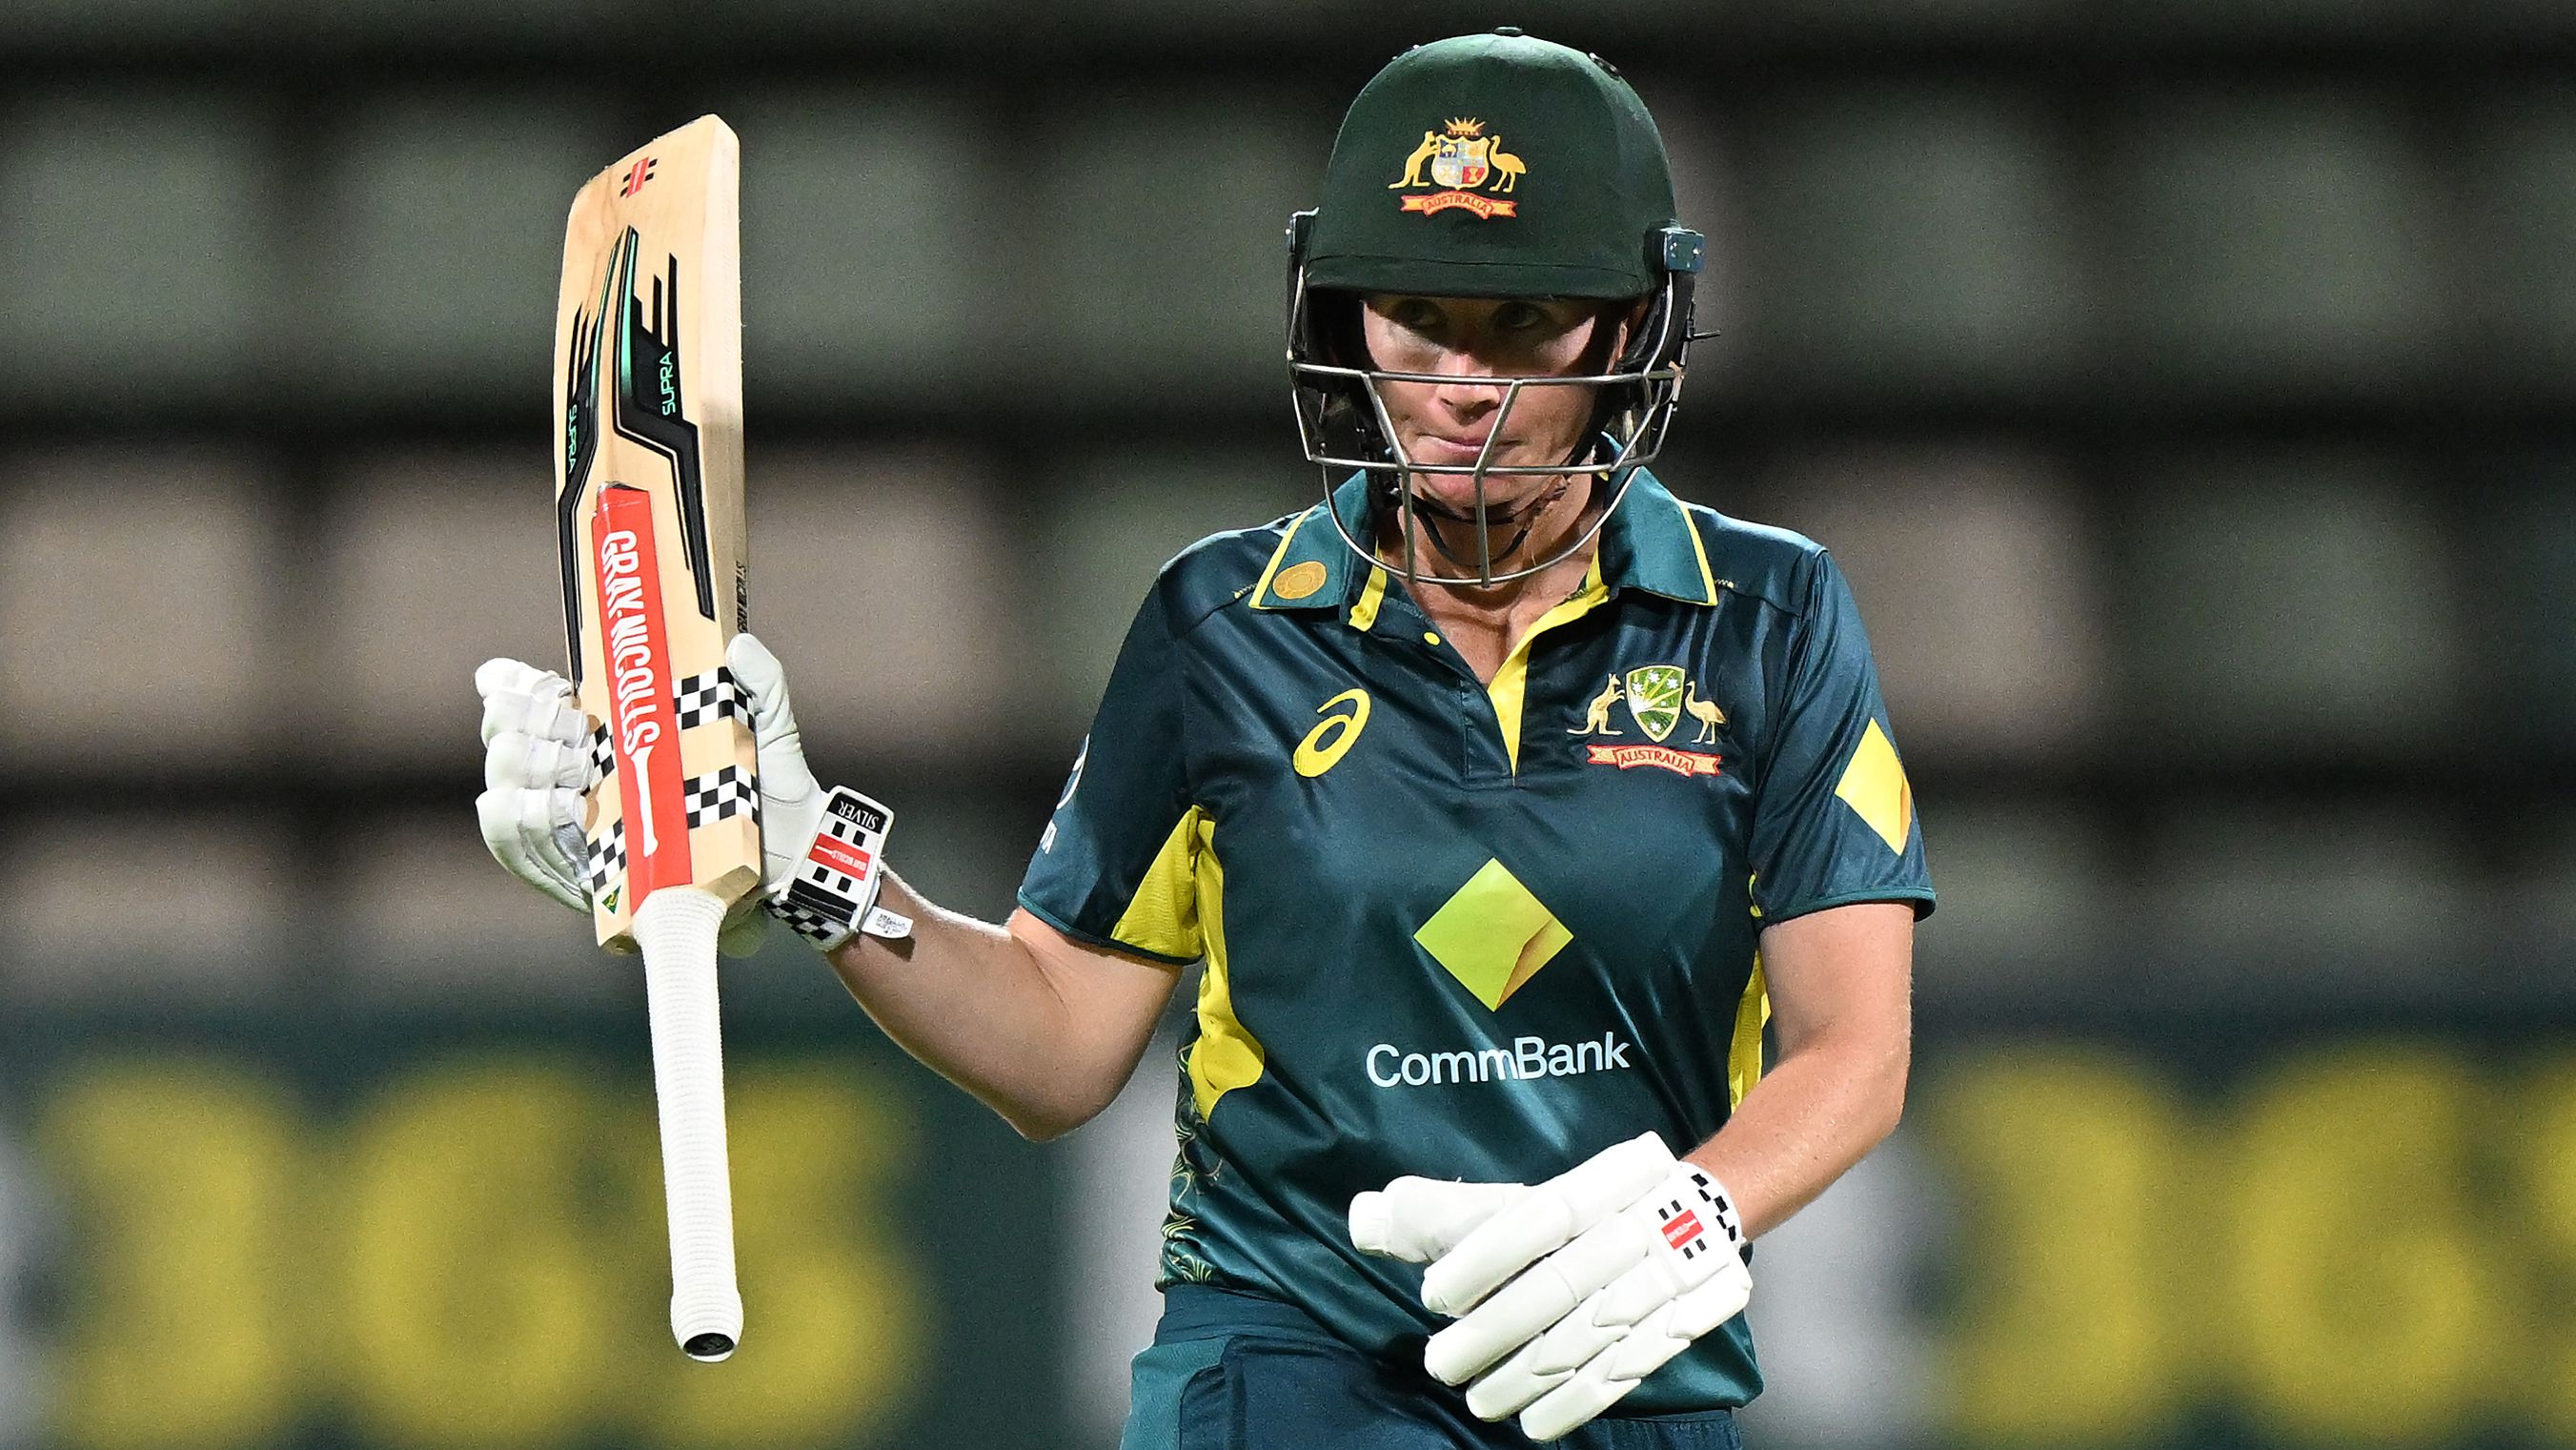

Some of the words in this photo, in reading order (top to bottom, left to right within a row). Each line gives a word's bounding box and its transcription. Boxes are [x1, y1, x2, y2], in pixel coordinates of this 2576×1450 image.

[1427, 194, 1489, 214] AUSTRALIA
[659, 350, 677, 417] SUPRA
[567, 403, 578, 475] SUPRA
[600, 530, 661, 756] GRAY-NICOLLS
[1619, 748, 1692, 773] AUSTRALIA
[838, 800, 880, 830] SILVER
[1366, 1031, 1632, 1088] CommBank
